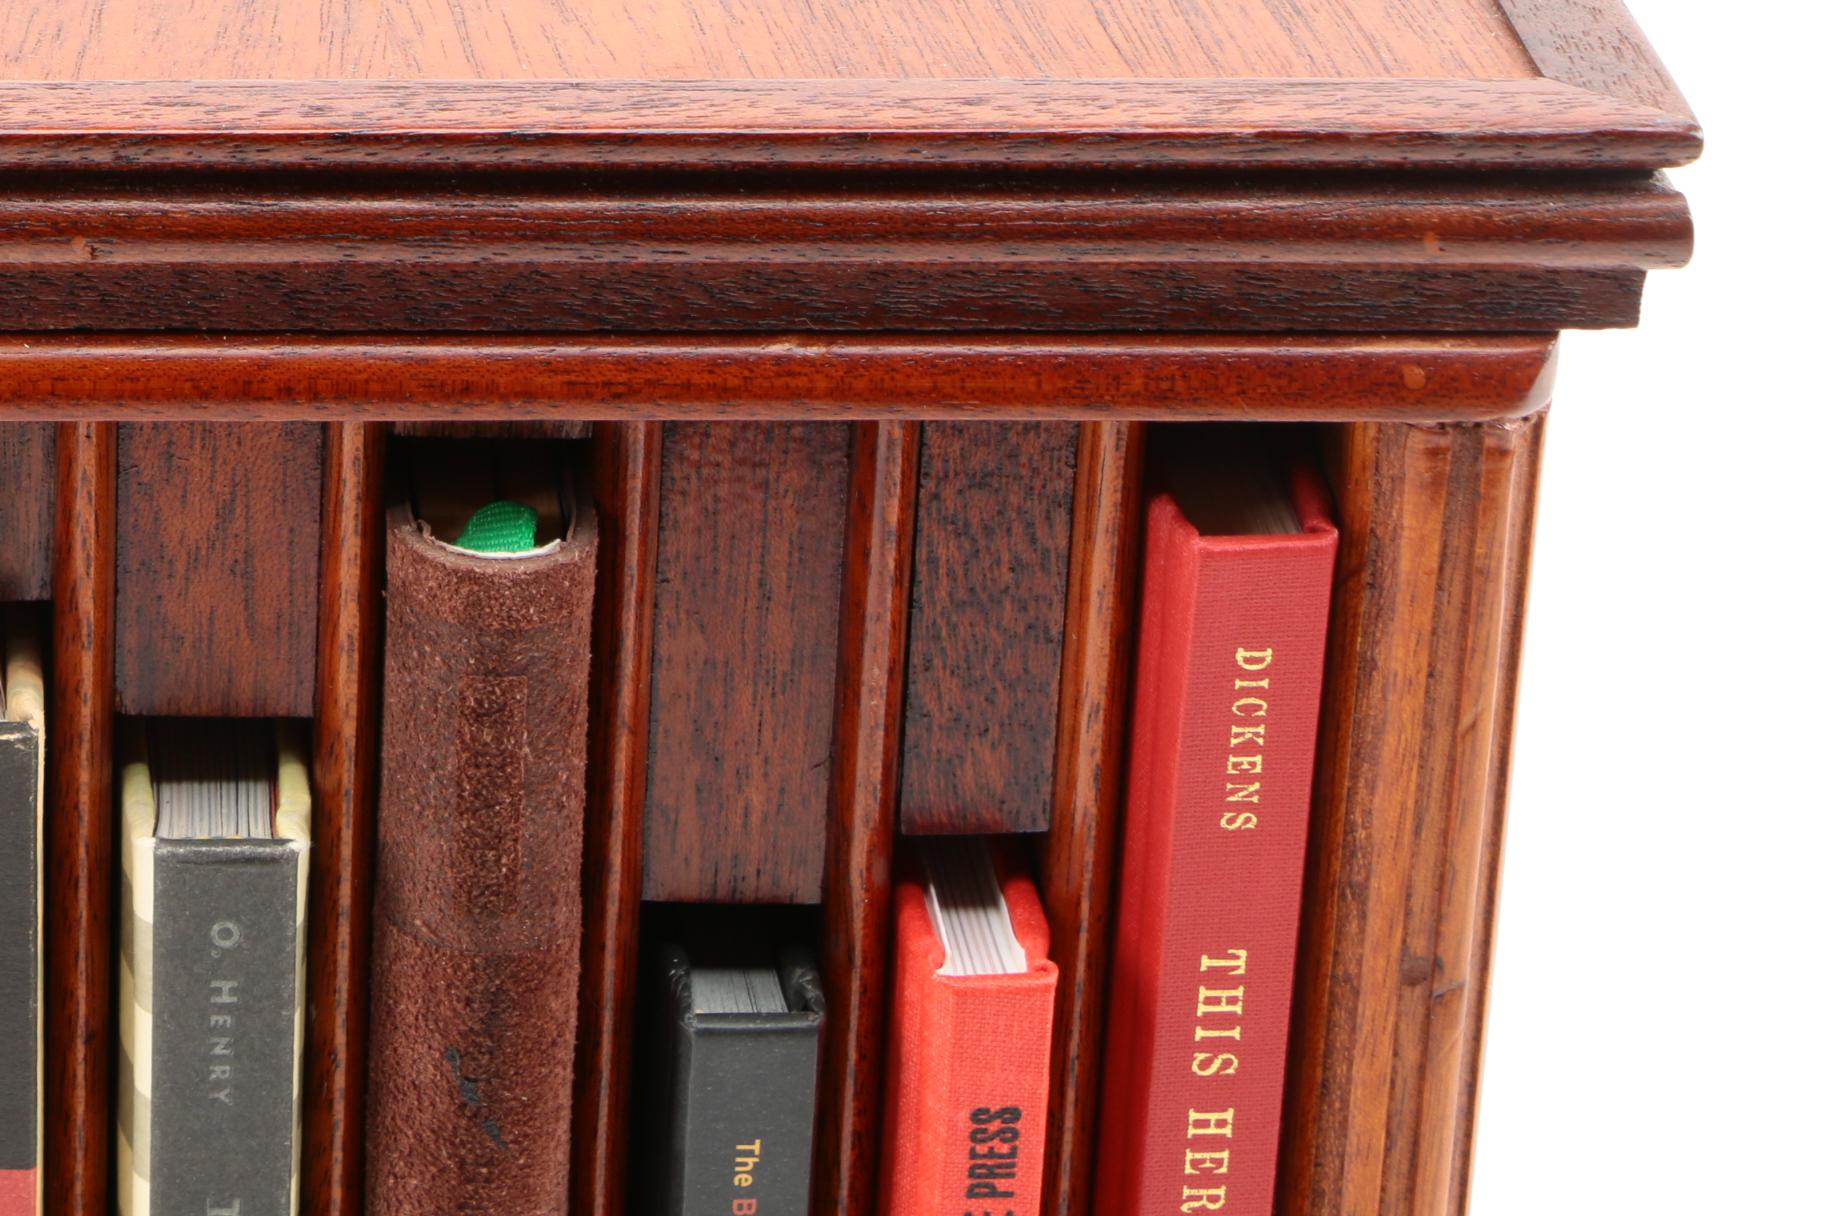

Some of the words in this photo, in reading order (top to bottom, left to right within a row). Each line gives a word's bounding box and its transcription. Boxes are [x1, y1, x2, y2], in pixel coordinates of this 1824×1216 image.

[1220, 647, 1273, 831] DICKENS
[209, 981, 238, 1106] HENRY
[1191, 949, 1248, 1077] THIS
[733, 1139, 761, 1187] The
[965, 1106, 1022, 1199] PRESS
[1179, 1108, 1235, 1214] HER
